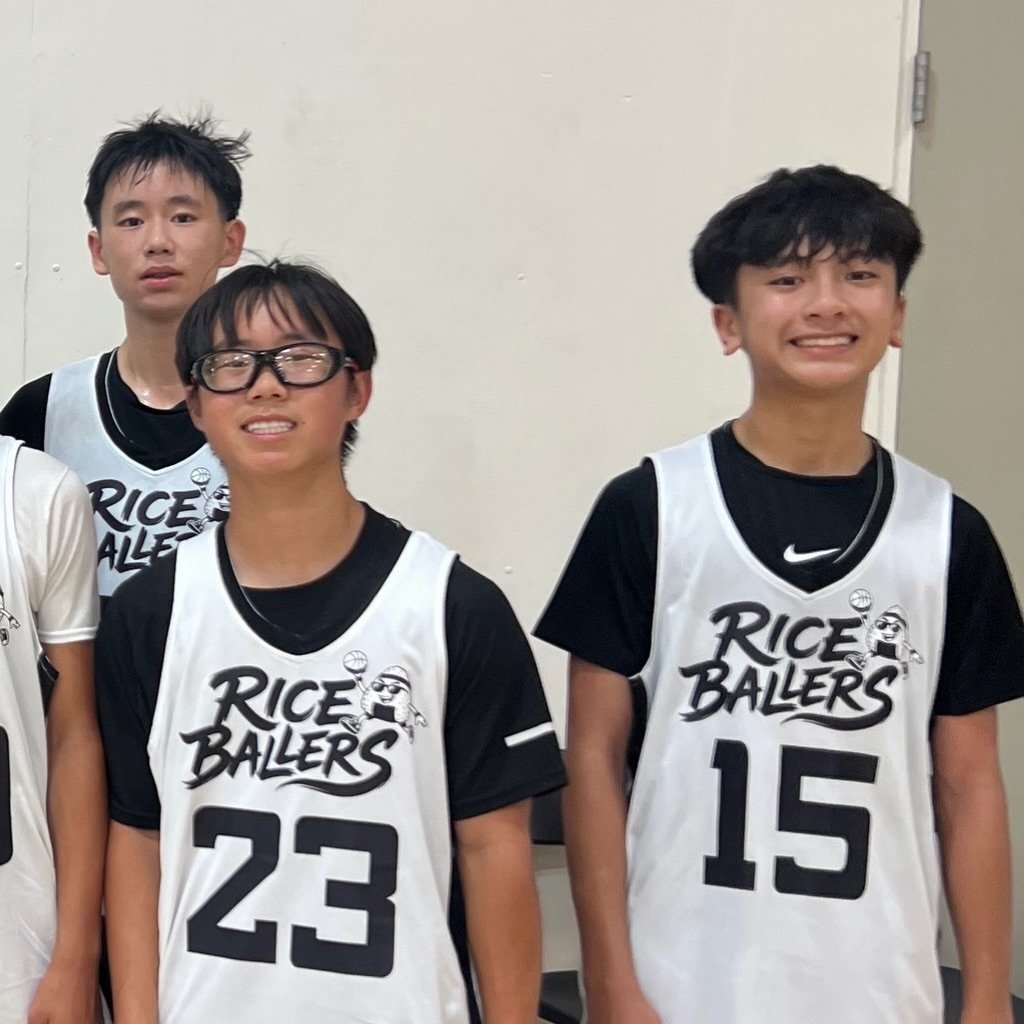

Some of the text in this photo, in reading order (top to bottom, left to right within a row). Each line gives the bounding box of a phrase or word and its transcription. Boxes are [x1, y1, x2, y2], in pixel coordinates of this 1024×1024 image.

[86, 479, 202, 532] RICE
[97, 527, 198, 573] ALLE
[711, 601, 862, 666] RICE
[208, 666, 358, 730] RICE
[679, 660, 894, 730] BALLERS
[180, 727, 398, 797] BALLERS
[703, 739, 879, 900] 15
[186, 807, 398, 978] 23
